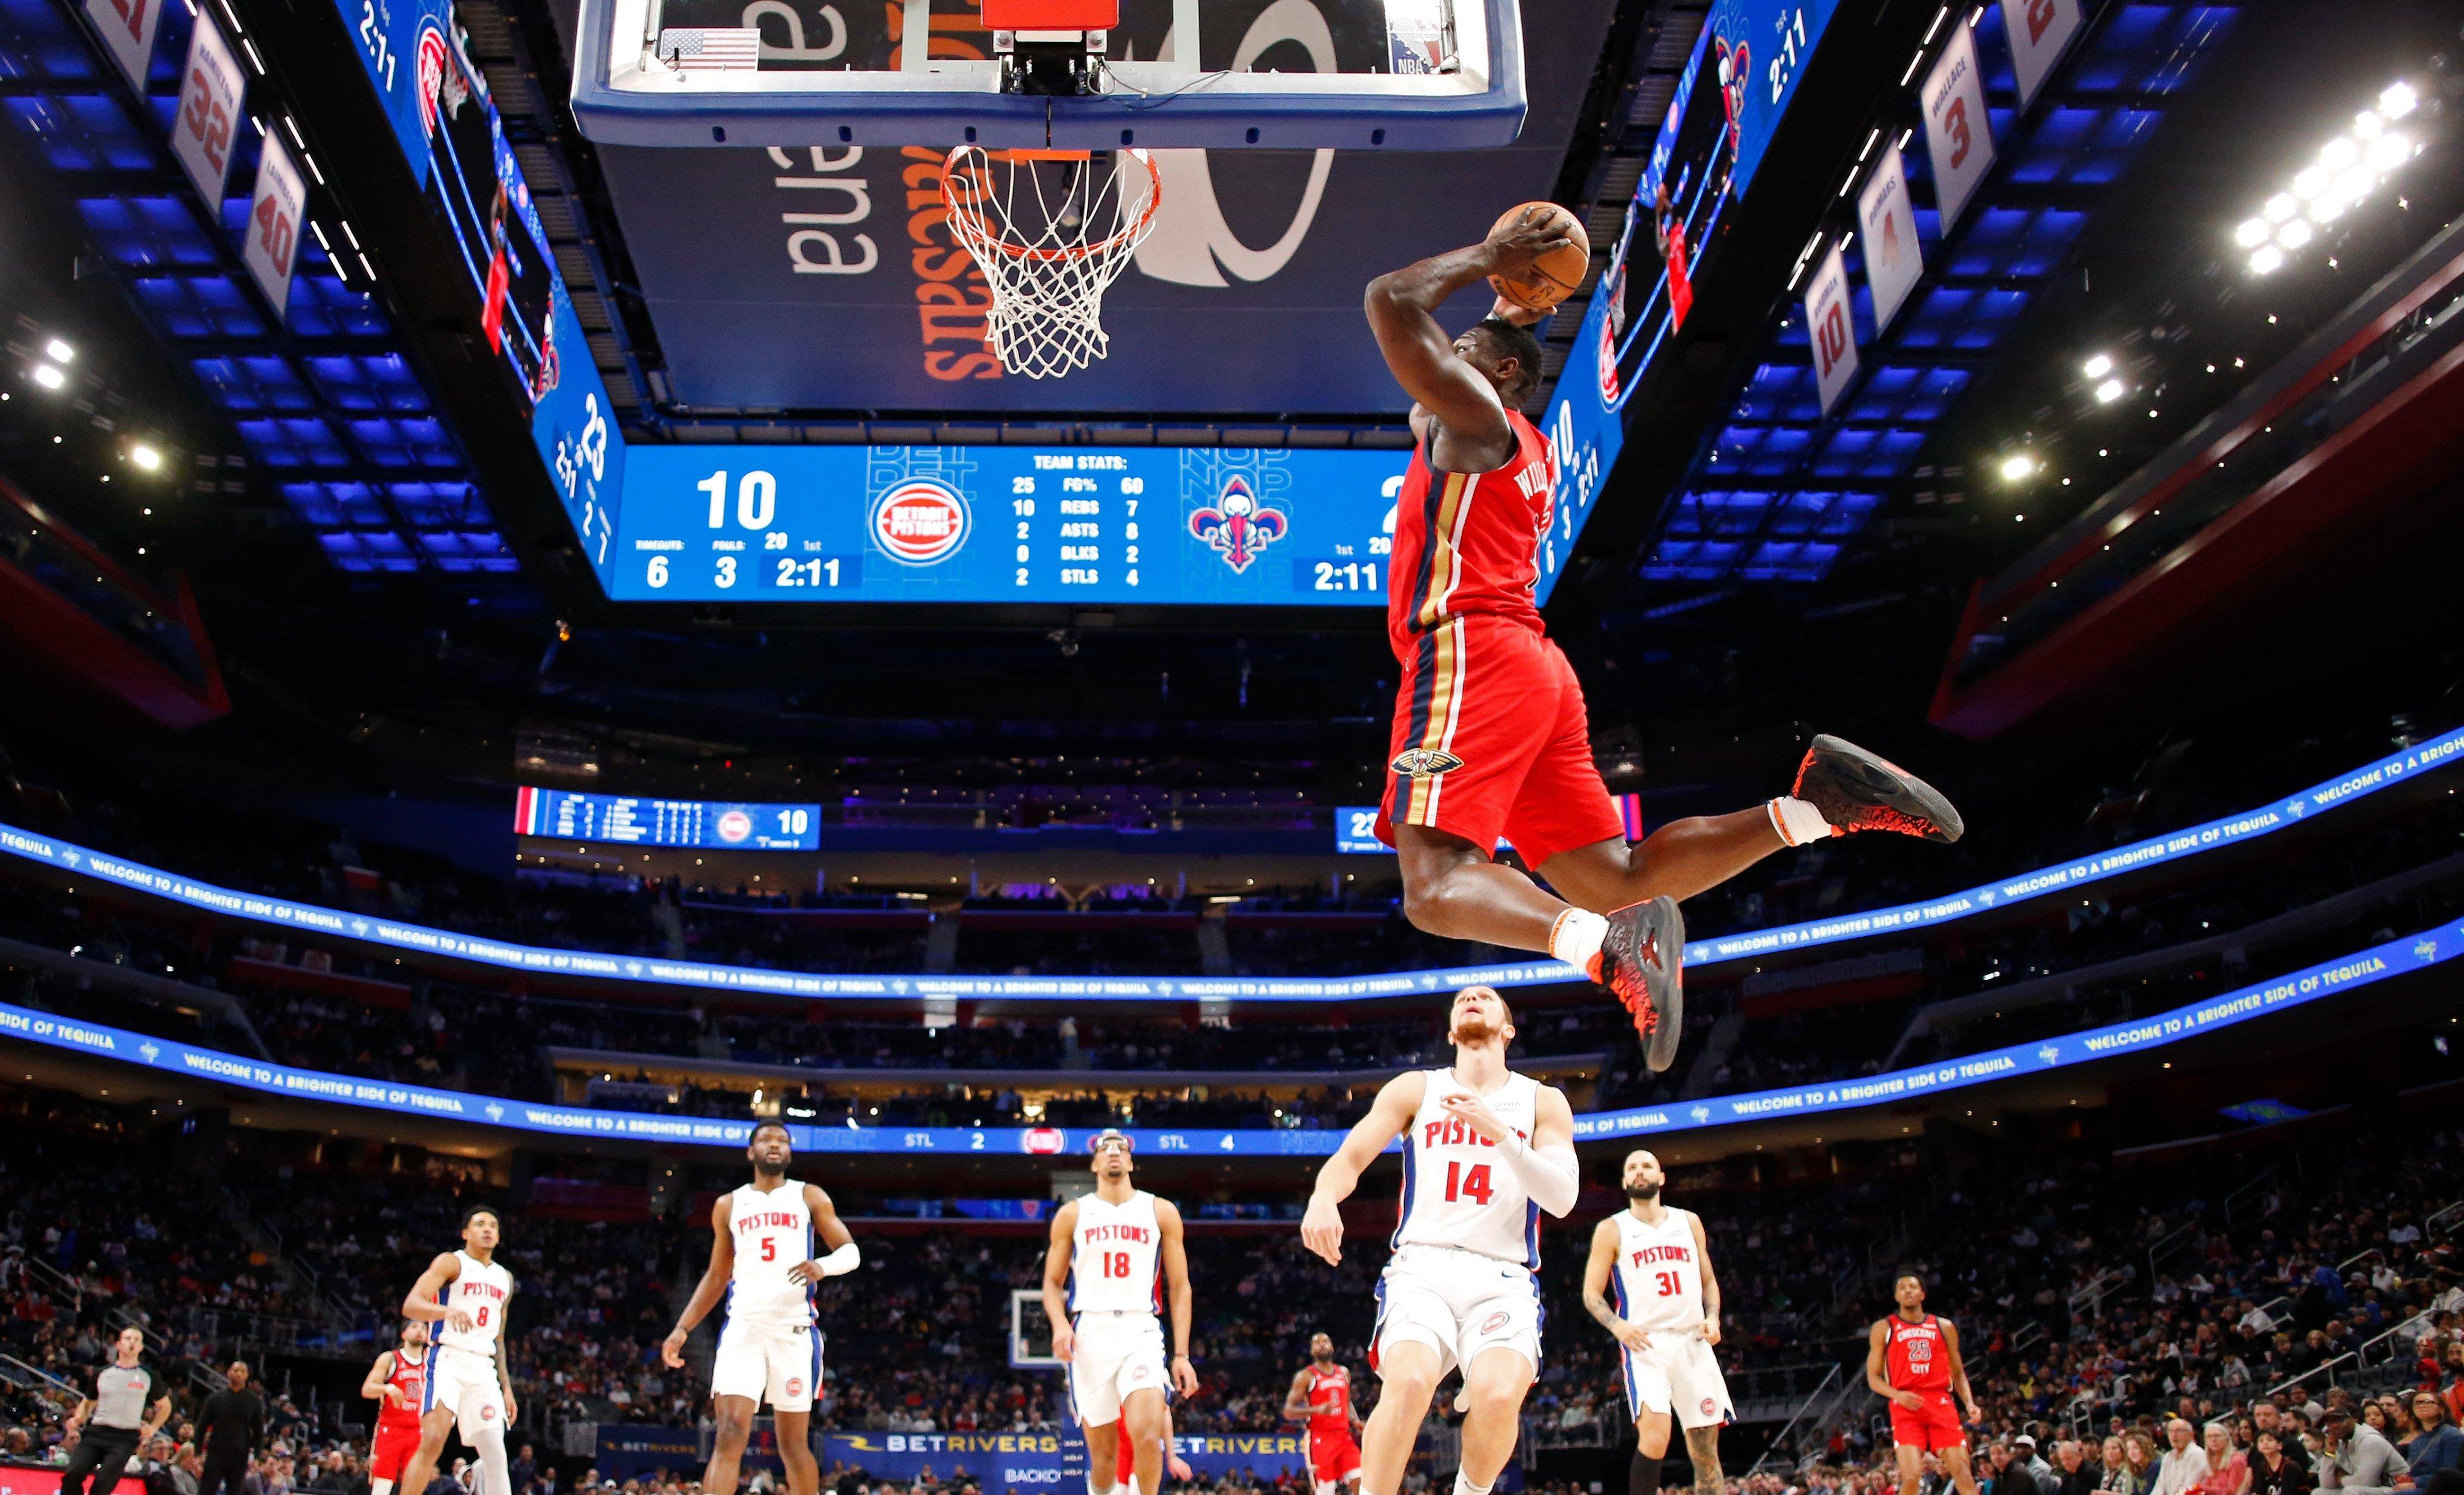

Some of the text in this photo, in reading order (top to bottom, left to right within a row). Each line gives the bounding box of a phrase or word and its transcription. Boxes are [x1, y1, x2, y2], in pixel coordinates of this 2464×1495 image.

[360, 0, 395, 92] 2:11
[1769, 8, 1806, 105] 2:11
[1398, 58, 1423, 75] NBA
[186, 67, 230, 176] 32
[1944, 96, 1971, 169] 3
[257, 193, 293, 278] 40
[1819, 301, 1846, 380] 10
[581, 392, 607, 481] 23
[1551, 399, 1574, 486] 10
[1033, 455, 1128, 470] TEAM STATS:
[1012, 476, 1144, 495] 25 FG% 60
[697, 470, 777, 531] 10
[1012, 499, 1139, 517] 10 REBS 7
[1381, 475, 1405, 533] 2
[890, 520, 951, 536] PISTONS
[1017, 522, 1139, 540] 2 ASTS 8
[764, 532, 788, 550] 20
[1369, 537, 1391, 554] 20
[1016, 544, 1139, 564] 0 BLKS 2
[647, 555, 669, 589] 6
[714, 555, 738, 589] 3
[776, 558, 840, 587] 2:11
[1015, 567, 1139, 587] 2 STLS 4
[1314, 562, 1377, 591] 2:11
[2314, 737, 2464, 804] WELCOME TO A BRIGH
[776, 809, 808, 836] 10
[2004, 813, 2279, 896] WELCOME TO A BRIGHTER SIDE OF TEQUILA
[90, 858, 343, 929] WELCOME TO A BRIGHTER SIDE OF TEQUILA
[1717, 899, 1971, 955] WELCOME TO A BRIGHTER SIDE OF TEQUILA
[2086, 958, 2386, 1051] WELCOME TO A BRIGHTER SIDE OF TEQUILA
[34, 1021, 54, 1035] OF
[58, 1025, 114, 1049] TEQUILA
[184, 1053, 463, 1112] WELCOME TO A BRIGHTER SIDE OF TEQUILA
[1733, 1057, 2015, 1114] WELCOME TO A BRIGHTER SIDE OF TEQUILA
[526, 1110, 742, 1139] WELCOME TO A BRIGHTER SIDE OF
[1572, 1113, 1668, 1135] IDE OF TEQUILA
[905, 1133, 934, 1147] STL
[972, 1132, 985, 1150] 2
[1159, 1135, 1189, 1150] STL
[1219, 1133, 1234, 1150] 4
[1446, 1161, 1494, 1205] 14
[738, 1212, 798, 1236] PISTONS
[1085, 1224, 1150, 1245] PISTONS
[761, 1238, 775, 1261] 5
[1632, 1246, 1690, 1268] PISTONS
[1103, 1252, 1130, 1278] 18
[464, 1282, 507, 1301] PISTON
[1656, 1271, 1682, 1296] 31
[477, 1306, 488, 1327] 8
[1896, 1327, 1936, 1343] CRESCENT
[1908, 1339, 1932, 1361] 25
[1911, 1361, 1930, 1375] CITY
[886, 1435, 1059, 1453] BETRIVERS
